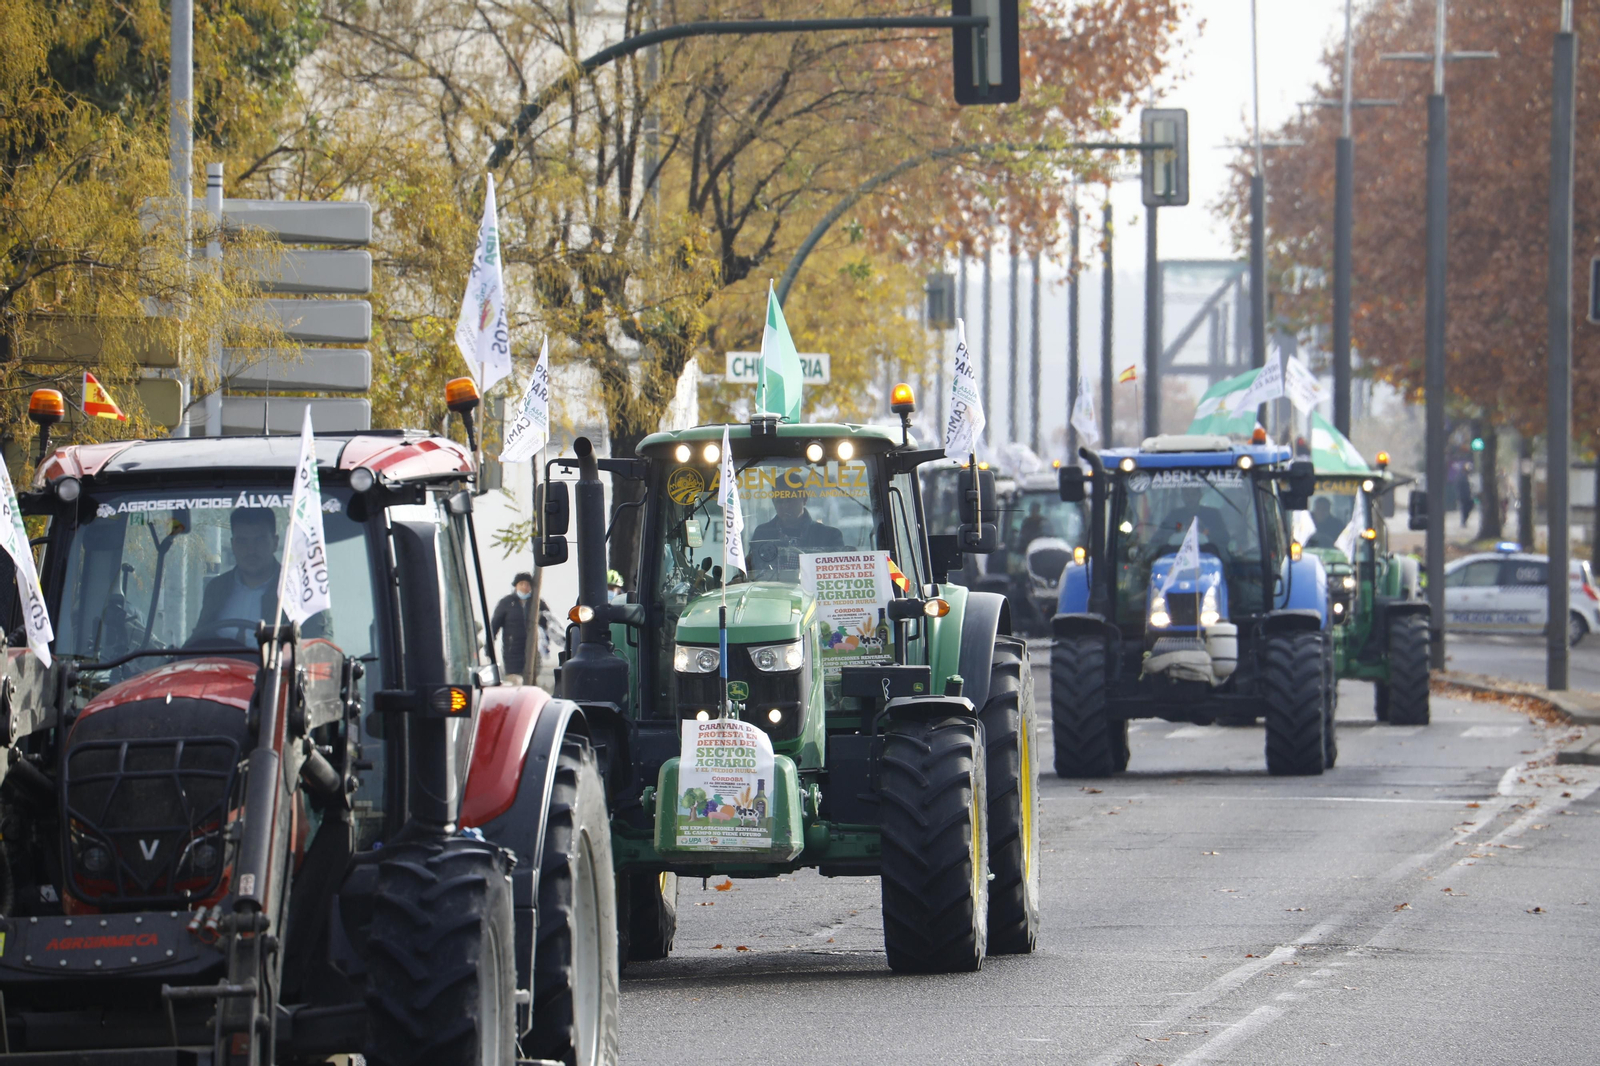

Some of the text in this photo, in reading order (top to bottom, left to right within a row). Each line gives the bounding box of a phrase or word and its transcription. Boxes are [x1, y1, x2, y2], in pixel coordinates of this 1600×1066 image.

[732, 358, 823, 377] CHRIA
[784, 466, 868, 488] CALEZ
[1152, 470, 1192, 482] ABEN
[754, 490, 817, 500] COOPERATIVA
[820, 489, 869, 498] ANDALUZA
[117, 490, 294, 514] AGROSERVICIOS ÁLVAR
[815, 556, 860, 564] CARAVANA
[816, 579, 874, 590] SECTOR
[817, 589, 876, 600] AGRARIO
[699, 723, 744, 731] CARAVANA
[696, 747, 756, 758] SECTOR
[695, 759, 756, 767] AGRARIO
